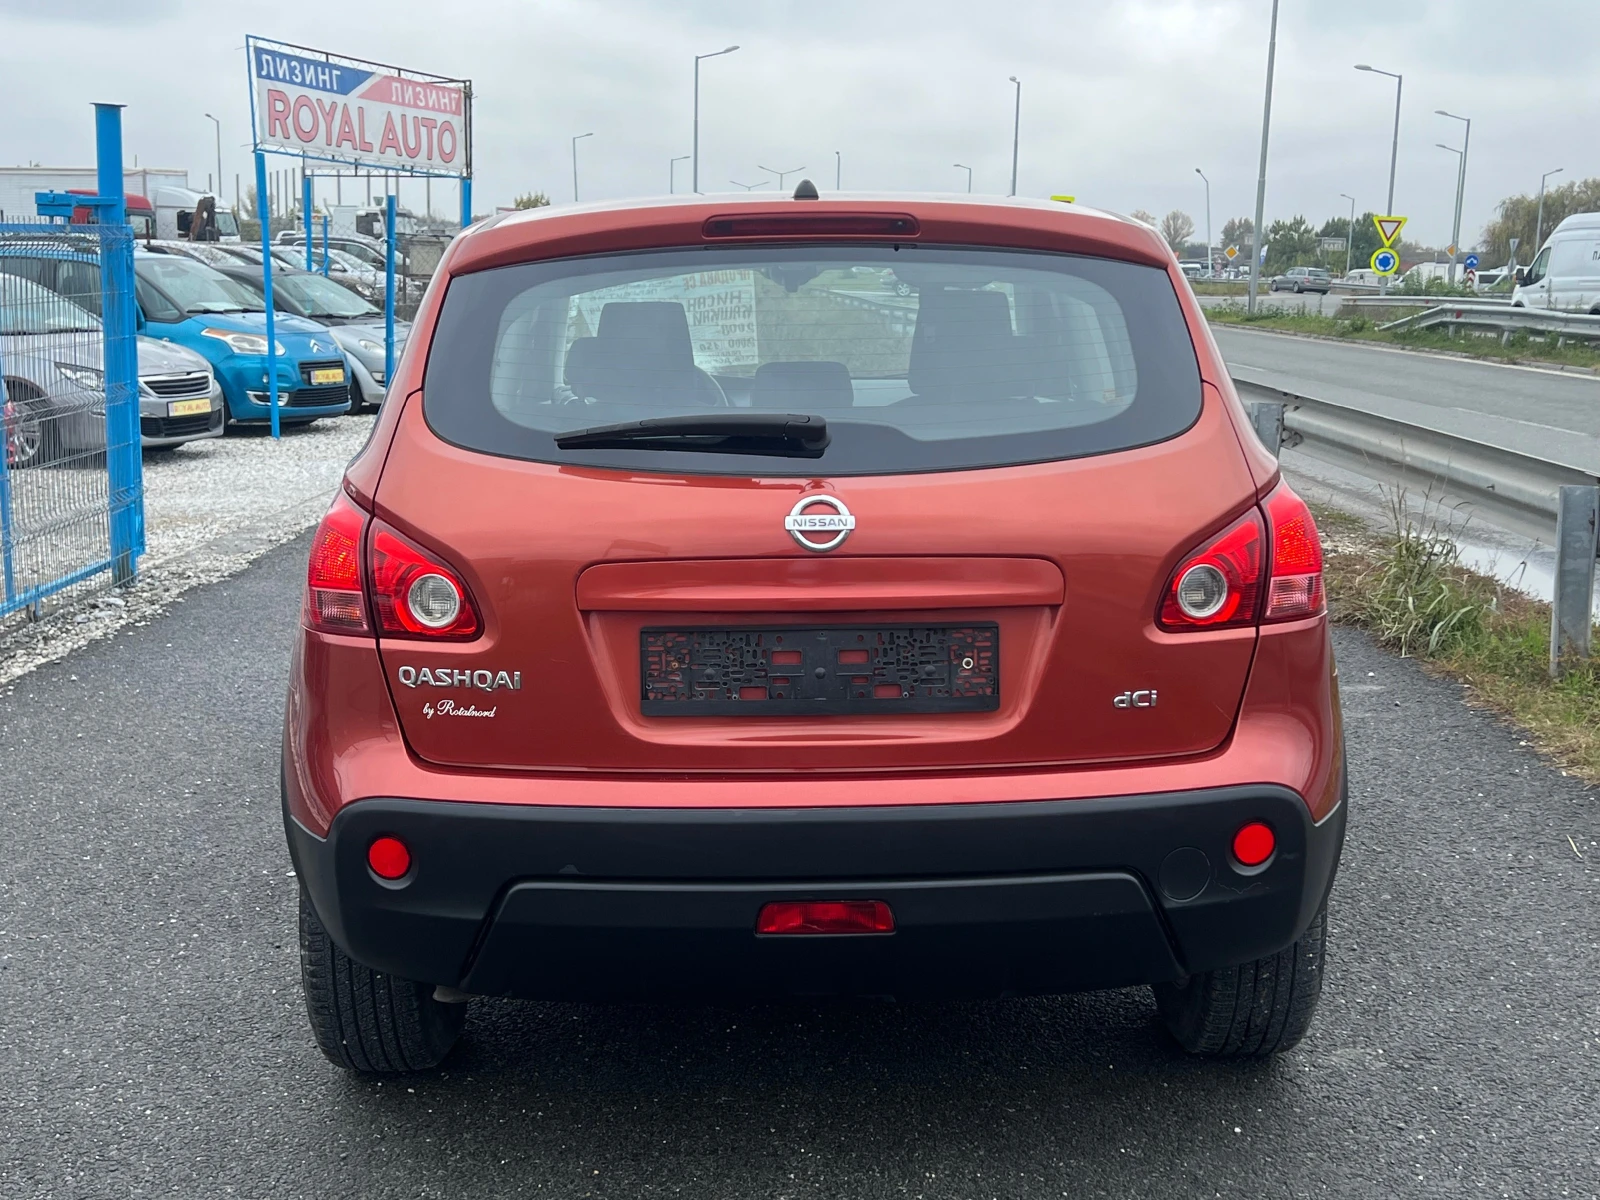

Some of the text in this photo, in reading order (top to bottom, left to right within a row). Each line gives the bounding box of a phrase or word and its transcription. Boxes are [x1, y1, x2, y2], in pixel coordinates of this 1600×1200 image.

[260, 54, 342, 91] ЛИЗИНГ
[390, 81, 460, 112] ЛИЗИНГ
[267, 88, 457, 164] ROYAL AUTO
[792, 518, 848, 527] NISSAN
[422, 699, 497, 719] by Rotalnord
[1113, 689, 1157, 709] dCi
